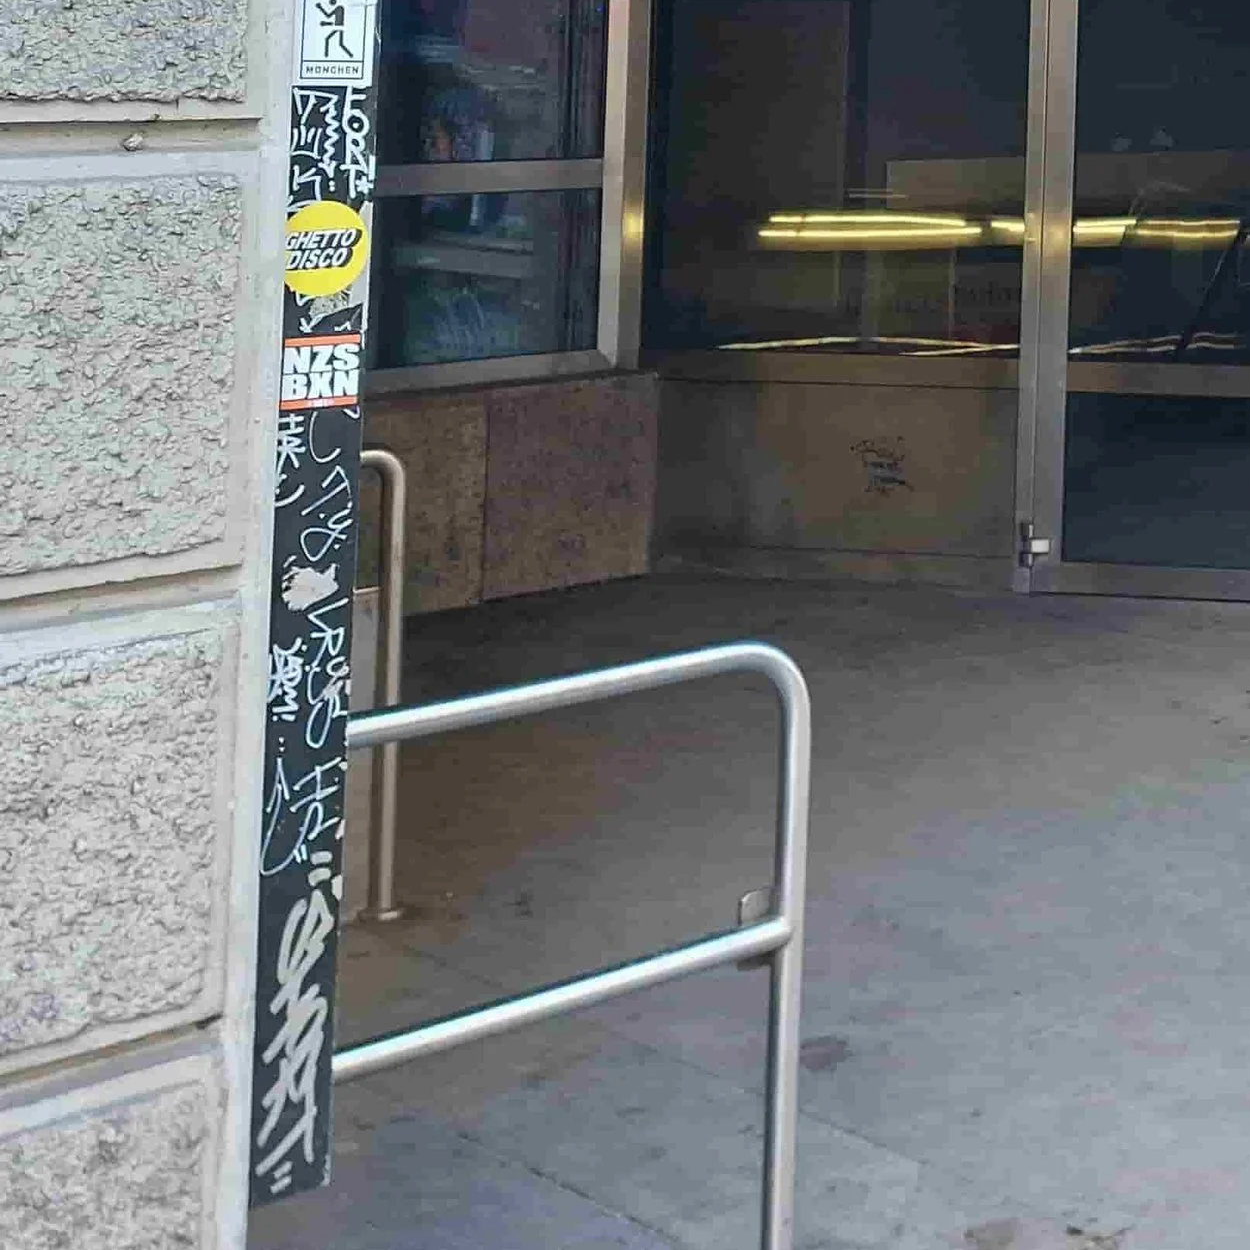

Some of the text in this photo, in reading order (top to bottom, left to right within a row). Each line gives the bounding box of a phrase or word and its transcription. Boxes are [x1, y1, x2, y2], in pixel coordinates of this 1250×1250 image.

[285, 228, 358, 250] GHETTO
[286, 248, 350, 270] DISCO
[284, 343, 360, 374] NZS
[282, 370, 359, 401] BXN
